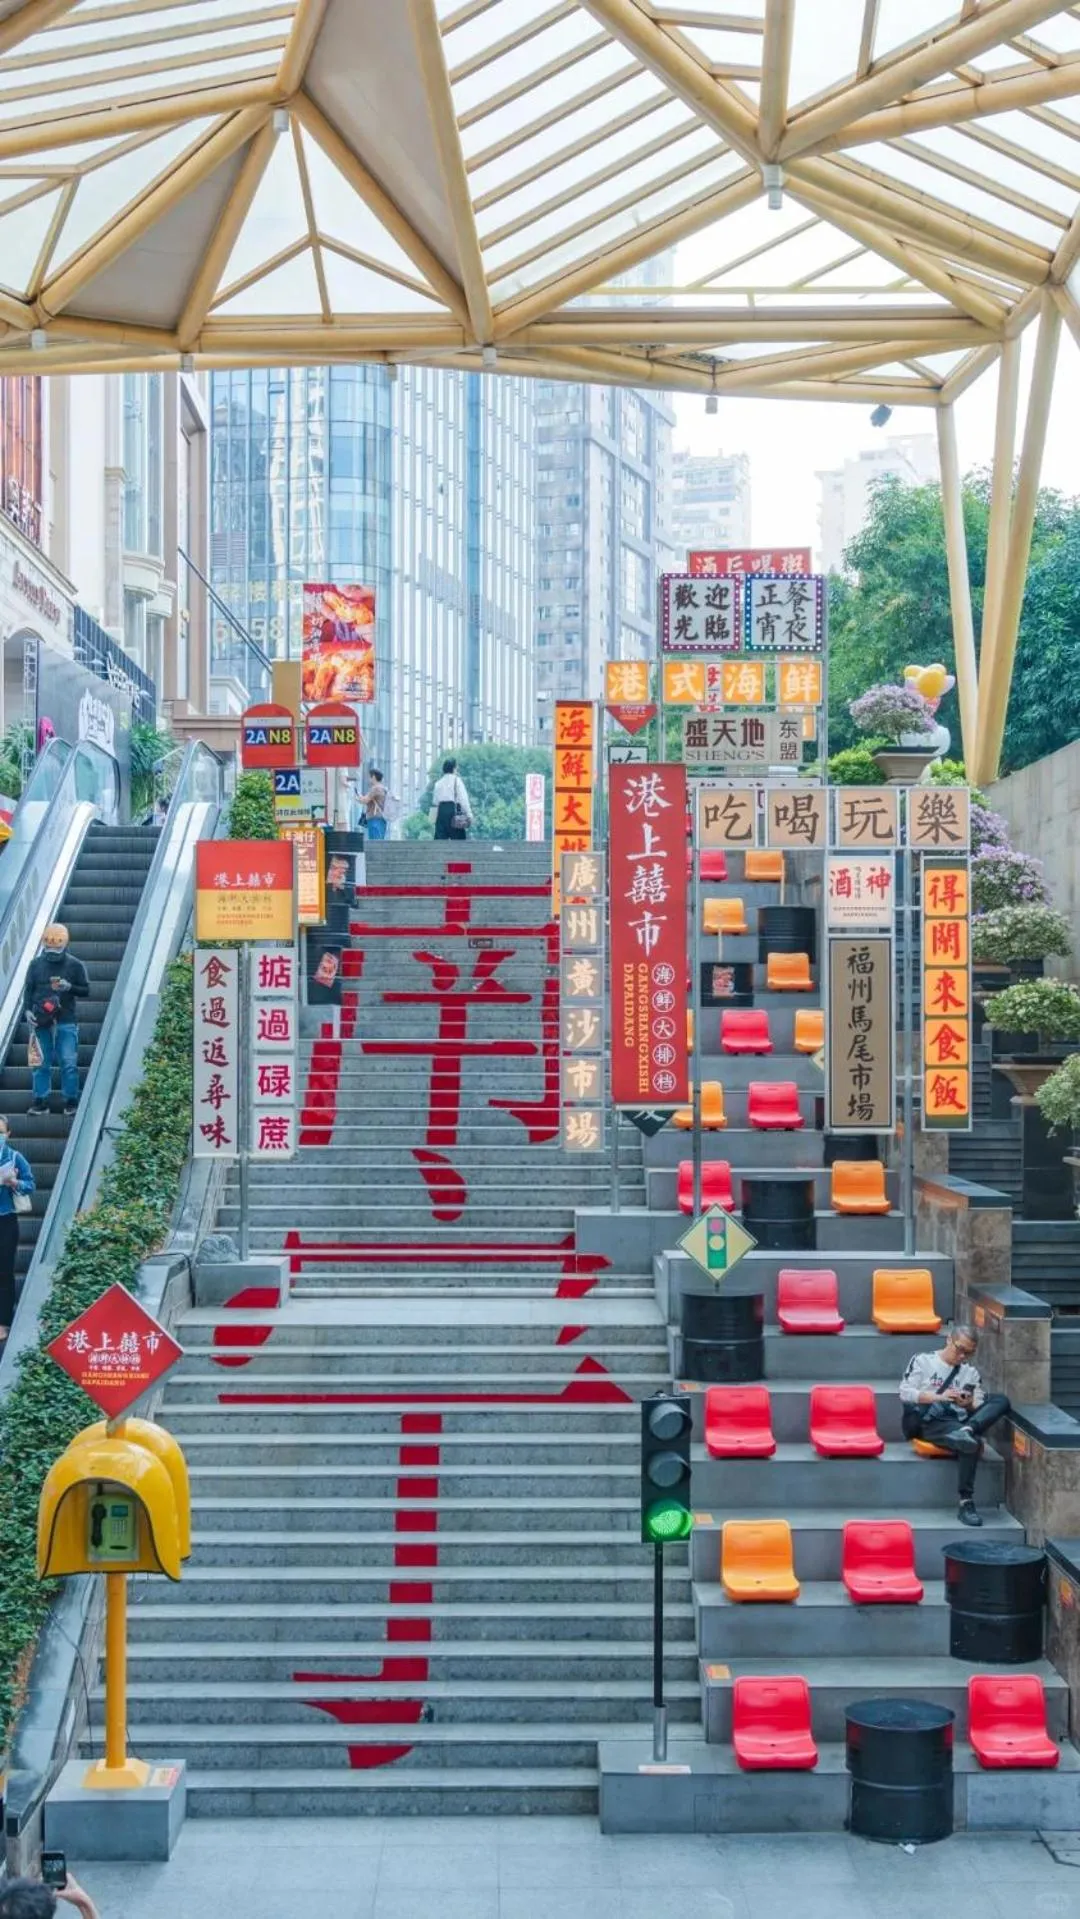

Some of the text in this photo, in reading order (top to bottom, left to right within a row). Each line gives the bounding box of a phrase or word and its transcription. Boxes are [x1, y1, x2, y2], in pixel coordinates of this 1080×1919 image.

[674, 583, 730, 610] 歡迎
[755, 582, 813, 612] 正餐
[674, 614, 730, 641] 光臨
[756, 613, 811, 643] 宵夜
[246, 729, 291, 744] 2A N8
[311, 729, 356, 744] 2A N8
[686, 718, 765, 747] 盛天地
[685, 751, 766, 761] SHENG'S
[276, 774, 299, 791] 2A
[704, 795, 963, 844] 吃喝玩樂
[829, 867, 892, 900] 酒神
[624, 963, 635, 1048] DAPAIDANG
[638, 963, 650, 1094] GANGSHANGXISHI
[847, 946, 874, 1121] 福州馬尾市場
[257, 955, 291, 1149] 掂過碌蔗
